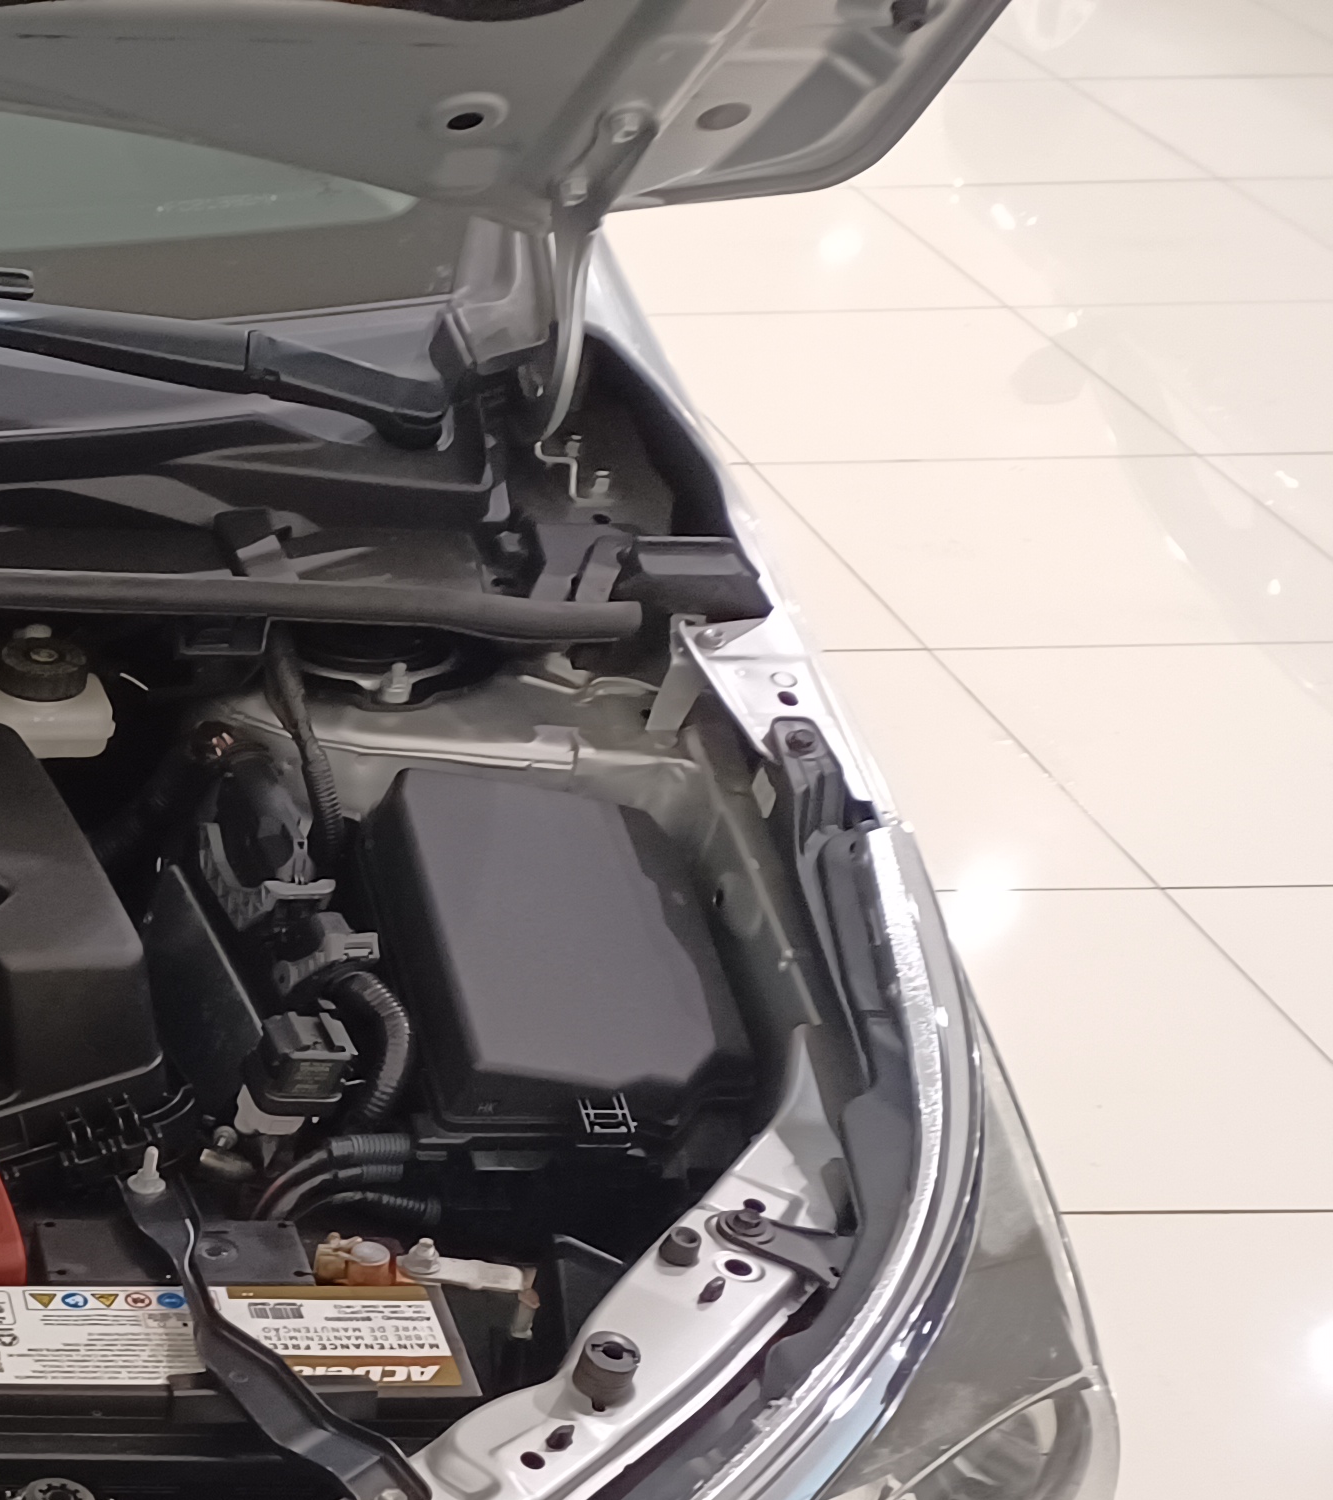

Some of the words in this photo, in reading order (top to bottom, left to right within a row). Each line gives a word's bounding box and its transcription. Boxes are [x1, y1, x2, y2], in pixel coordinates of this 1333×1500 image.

[261, 1325, 362, 1336] MANUTENÇÃO
[368, 1325, 387, 1334] DE
[392, 1325, 435, 1334] LIVRE
[256, 1333, 364, 1342] MANTENIMIEN
[368, 1333, 387, 1342] DE
[395, 1333, 437, 1342] LIBRE
[269, 1342, 312, 1351] FREE
[318, 1342, 441, 1351] MAINTENANCE
